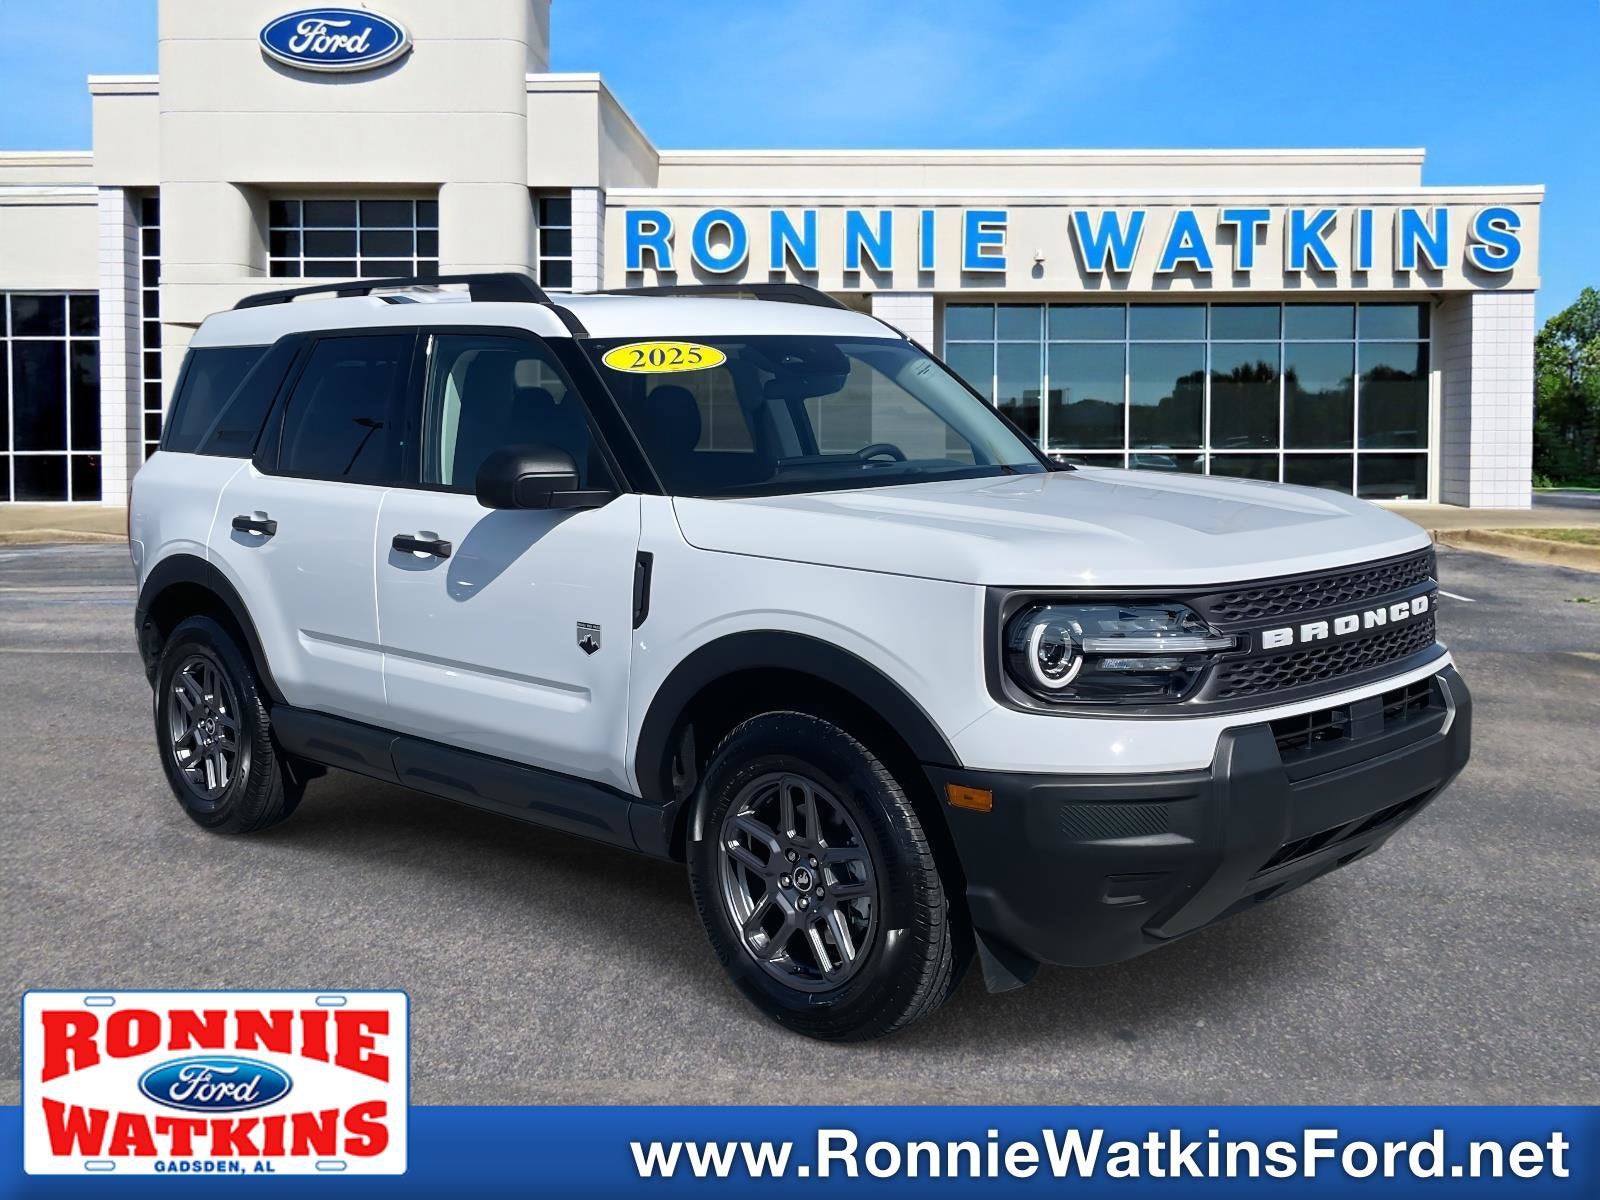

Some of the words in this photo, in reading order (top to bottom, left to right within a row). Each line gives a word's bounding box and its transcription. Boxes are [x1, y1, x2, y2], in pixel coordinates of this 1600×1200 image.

[288, 18, 372, 54] Ford
[625, 208, 1010, 274] RONNIE
[1070, 207, 1523, 274] WATKINS
[629, 347, 703, 369] 2025
[1262, 595, 1429, 650] BRONCO
